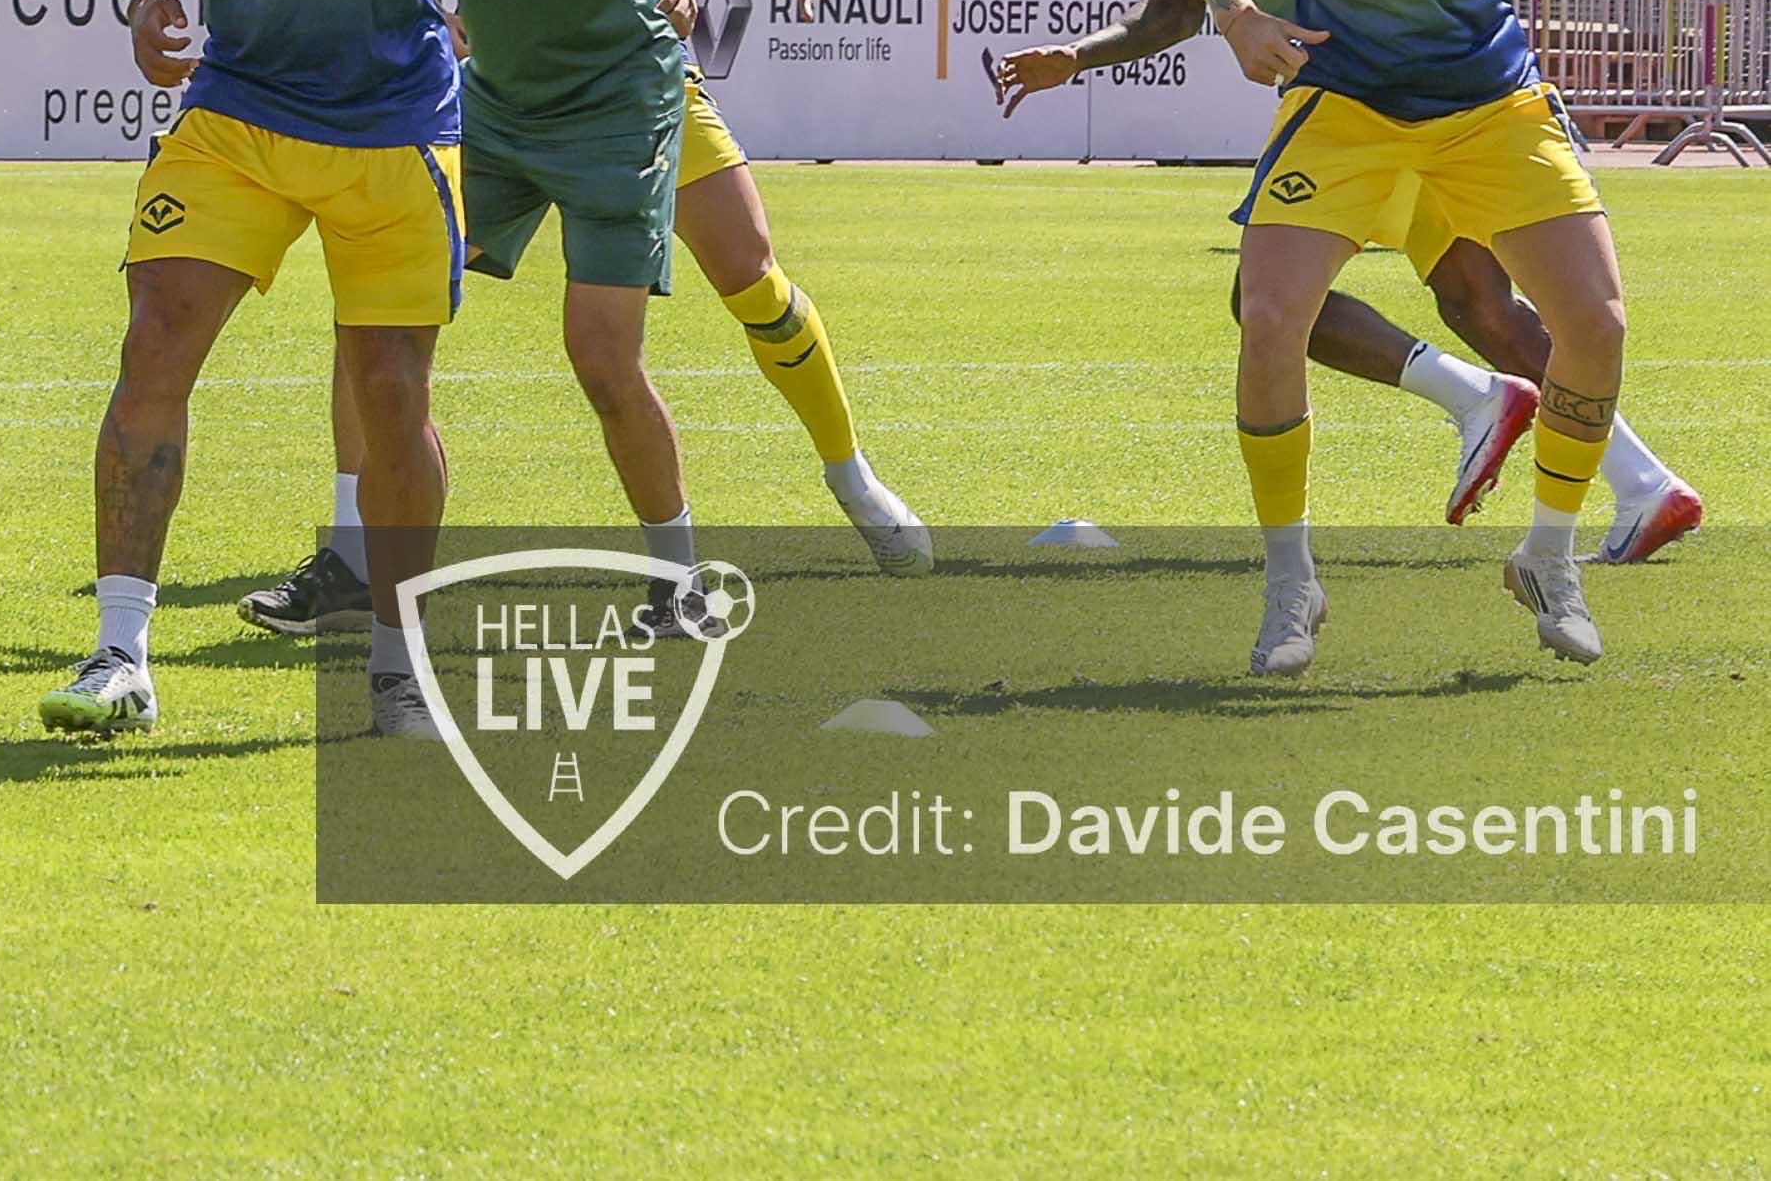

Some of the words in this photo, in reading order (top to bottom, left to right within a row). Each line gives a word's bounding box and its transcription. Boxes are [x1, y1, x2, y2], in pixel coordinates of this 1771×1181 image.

[953, 0, 1039, 35] JOSEF
[768, 36, 834, 61] Passion
[838, 36, 862, 61] for
[866, 36, 892, 61] life
[1112, 53, 1187, 87] 64526
[43, 87, 172, 142] prege
